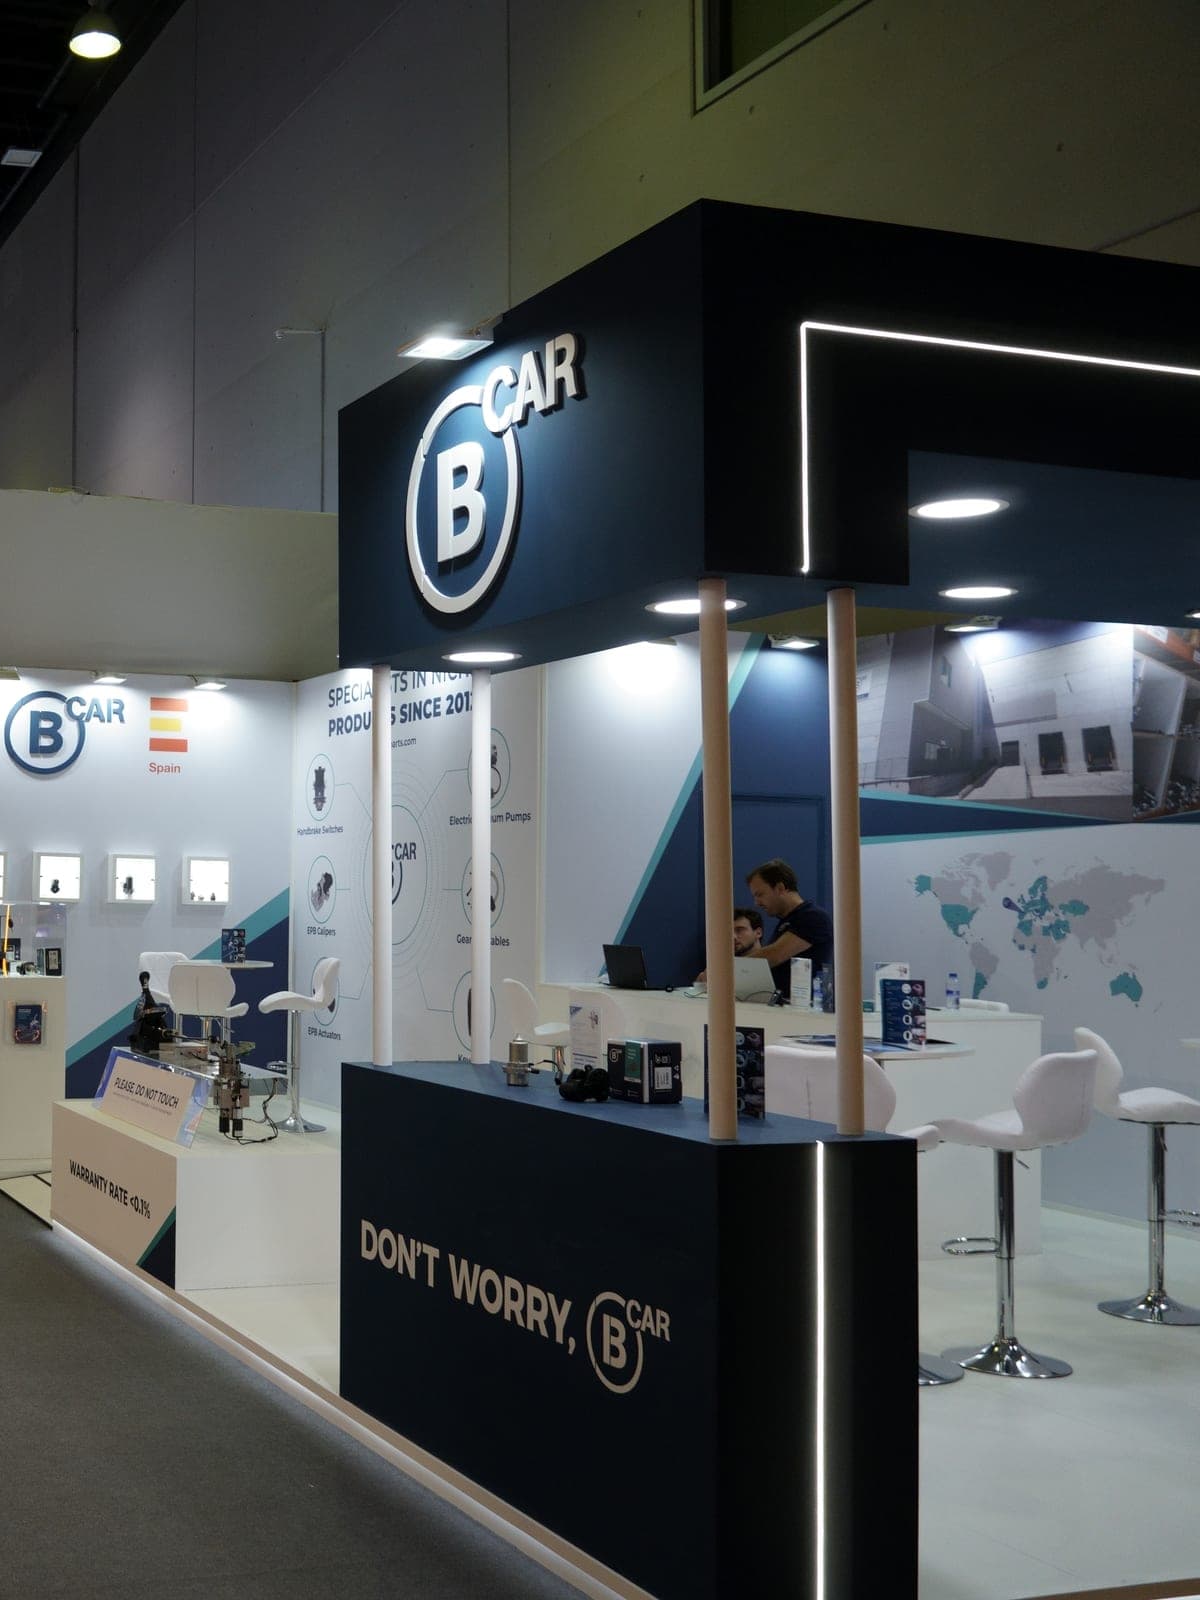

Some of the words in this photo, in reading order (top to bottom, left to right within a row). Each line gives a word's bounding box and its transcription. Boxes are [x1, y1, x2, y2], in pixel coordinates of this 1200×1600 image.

[328, 671, 408, 708] SPECIATS
[328, 705, 396, 737] PRODUS
[400, 697, 442, 723] SINCE
[446, 691, 473, 715] 201
[149, 762, 181, 774] Spain
[506, 811, 532, 824] Pumps
[307, 926, 317, 935] EPB
[318, 926, 336, 937] Calipers
[319, 1028, 341, 1041] Actuators
[135, 1084, 145, 1097] DO
[145, 1087, 158, 1101] NOT
[158, 1091, 179, 1108] TOUCH
[69, 1159, 108, 1194] WARRANTY
[109, 1184, 128, 1207] RATE
[361, 1219, 439, 1288] DON'T
[449, 1253, 576, 1355] WORRY,
